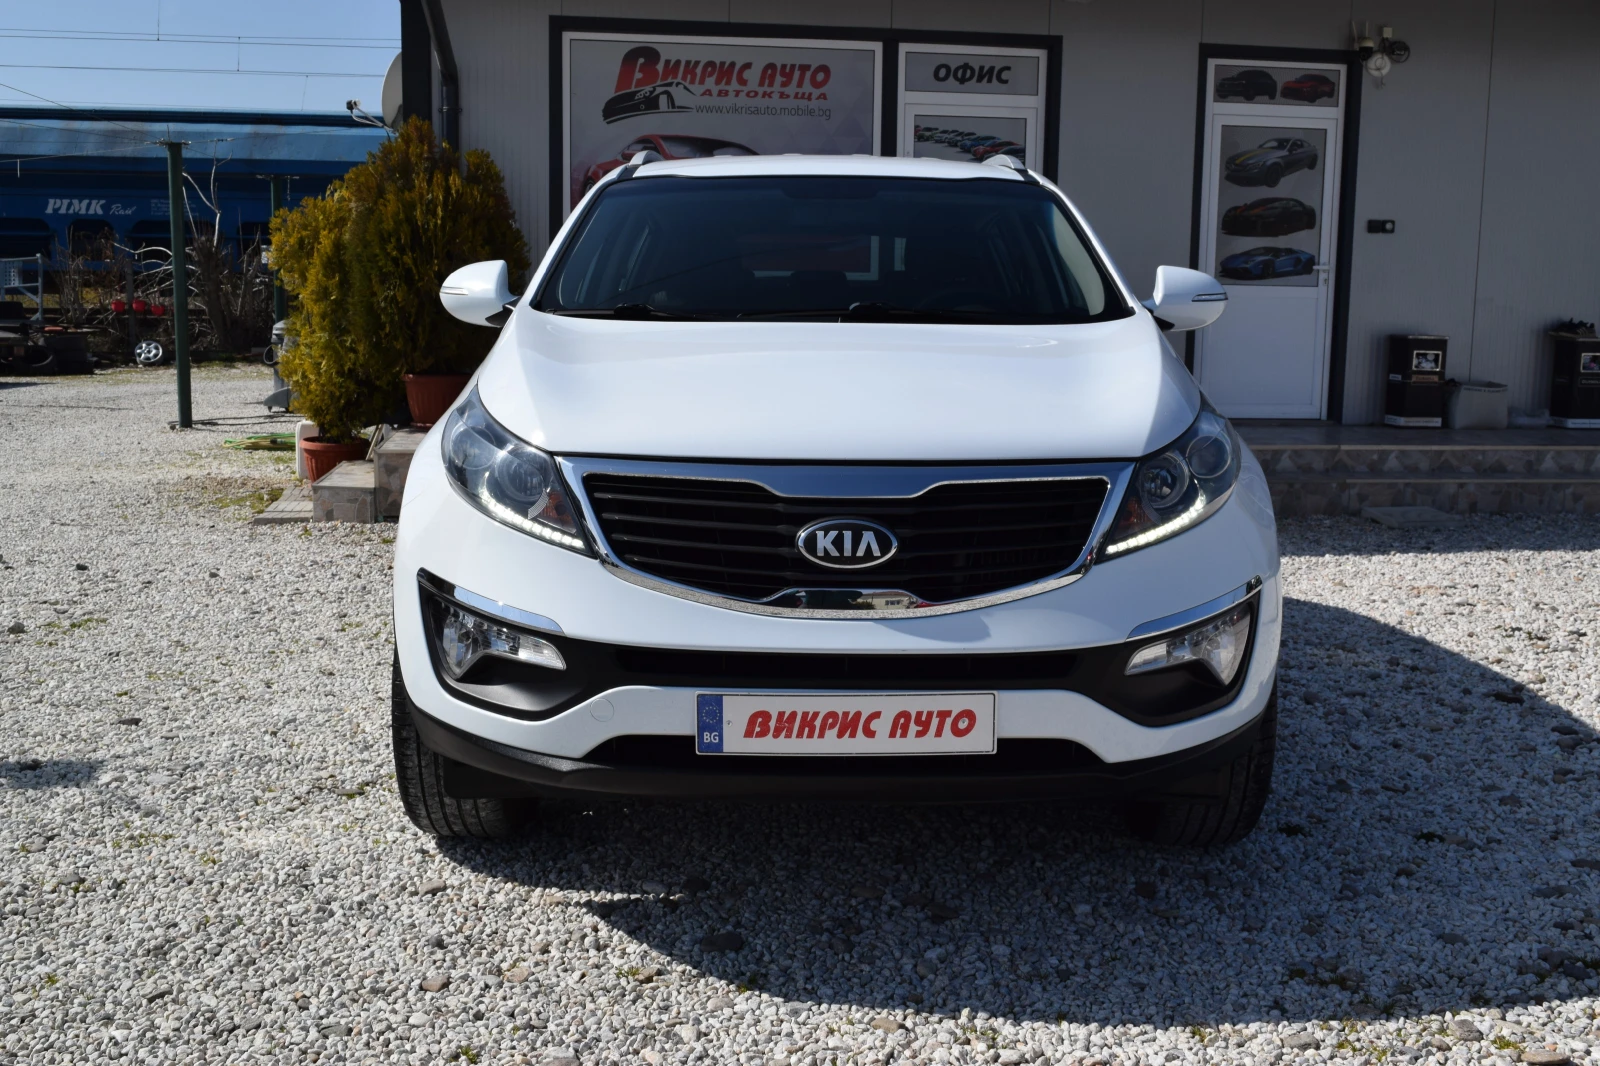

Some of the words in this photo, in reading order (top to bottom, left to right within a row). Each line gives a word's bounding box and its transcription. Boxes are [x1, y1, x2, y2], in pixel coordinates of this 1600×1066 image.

[614, 45, 753, 94] ВИКРИС
[757, 62, 832, 90] АУТО
[932, 62, 1012, 86] ОФИС
[699, 88, 829, 102] АВТОКЪЩА
[695, 102, 832, 121] www.vikrisauto.mobile.bg
[45, 198, 106, 215] PIMK
[815, 530, 881, 557] KIA
[743, 709, 882, 740] ВИКРИС
[888, 708, 977, 739] АУТО
[703, 731, 719, 744] BG
